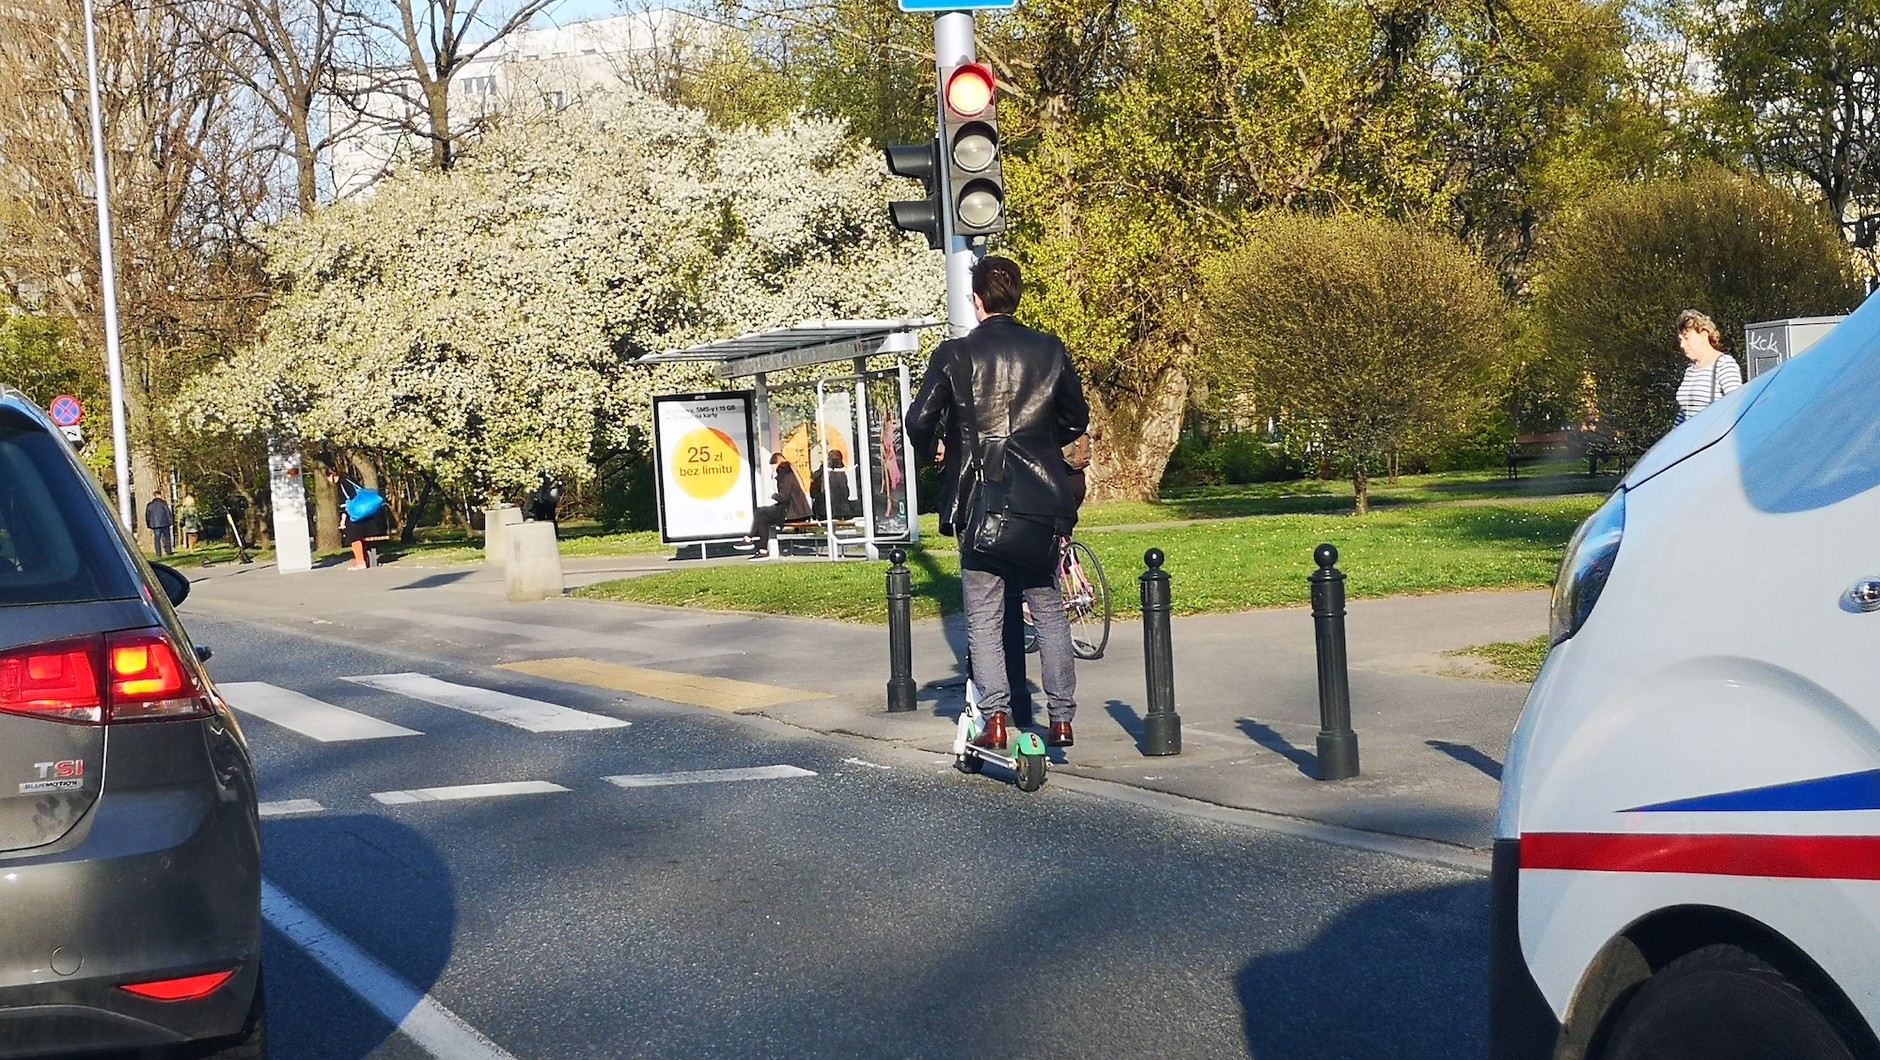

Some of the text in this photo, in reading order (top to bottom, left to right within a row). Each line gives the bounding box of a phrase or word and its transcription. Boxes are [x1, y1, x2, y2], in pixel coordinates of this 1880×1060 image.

[687, 446, 723, 463] 25 zł
[679, 465, 733, 477] bez limitu
[34, 759, 84, 779] TSI
